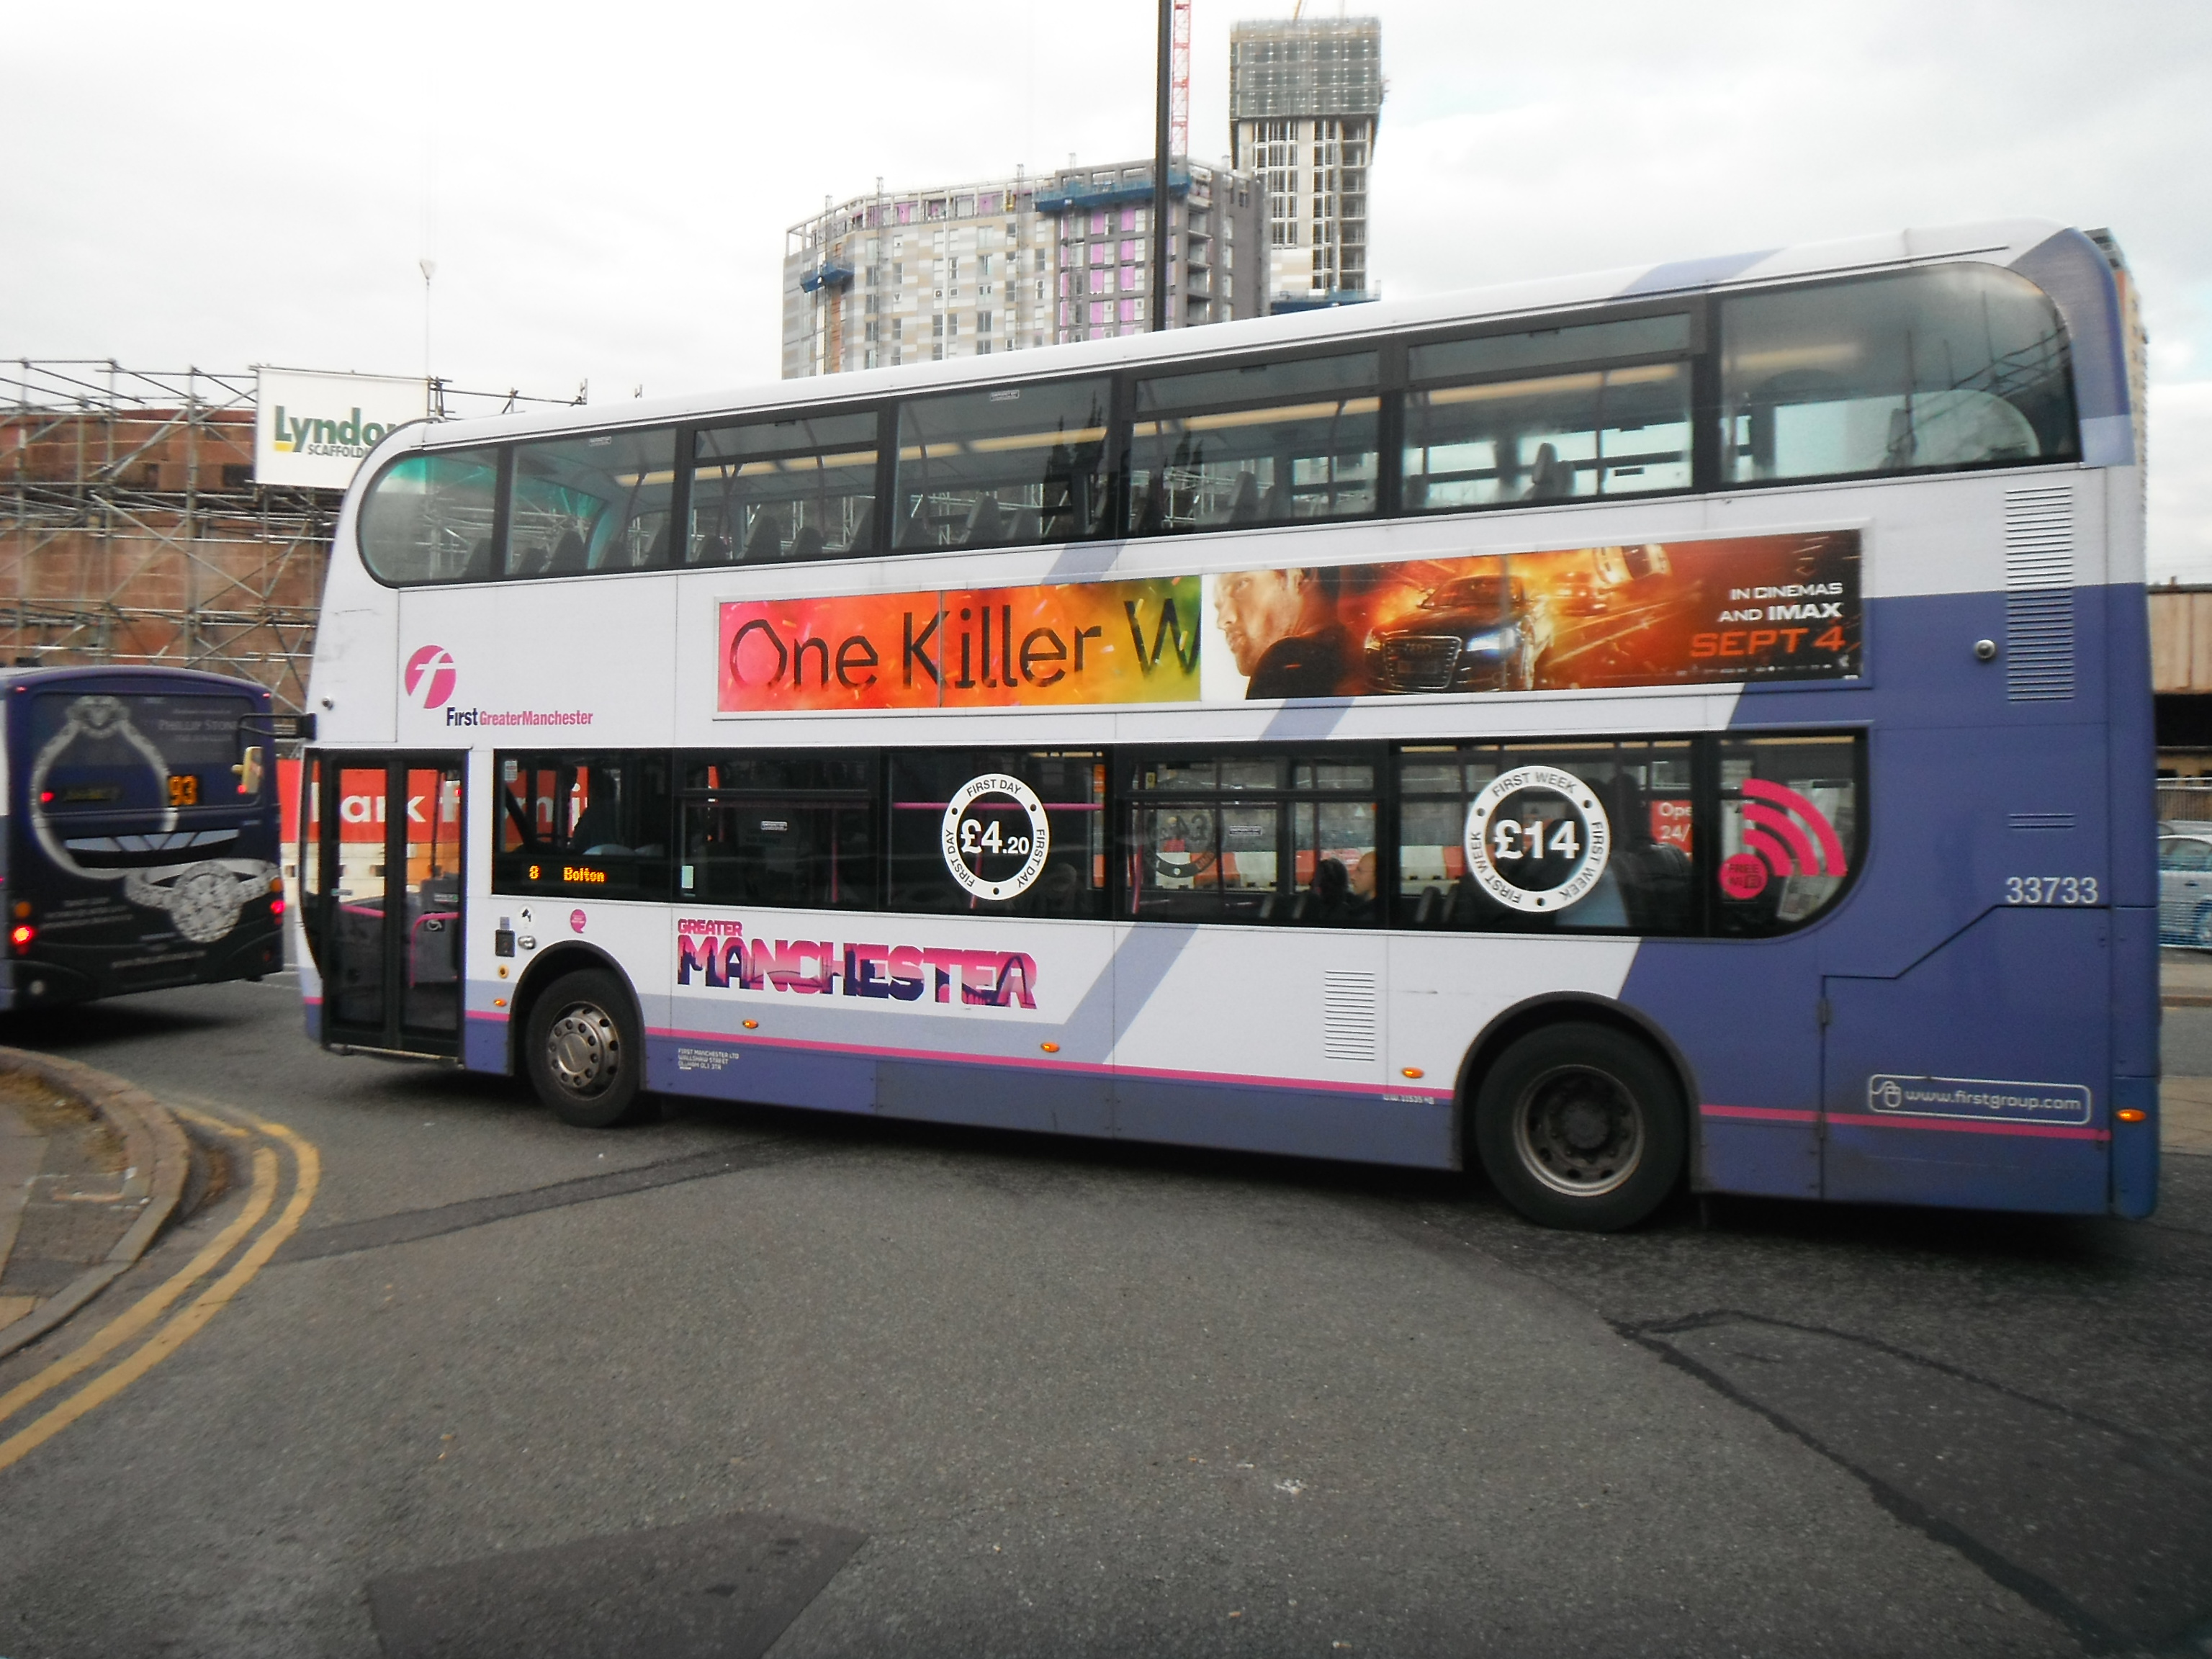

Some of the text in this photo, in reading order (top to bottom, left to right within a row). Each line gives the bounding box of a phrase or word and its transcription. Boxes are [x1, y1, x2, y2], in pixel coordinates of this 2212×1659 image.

[275, 405, 397, 453] Lyndo
[308, 443, 369, 459] SCAFFOLD
[1731, 582, 1843, 601] IN CINEMAS
[1717, 602, 1843, 623] AND IMAX
[729, 619, 878, 693] One
[902, 604, 1102, 690] Killer
[1691, 625, 1846, 657] SEPT 4
[446, 707, 594, 727] First GreaterManchester
[168, 775, 197, 806] 93
[966, 778, 1022, 797] FIRST DAY
[1491, 771, 1578, 797] FIRST WEEK
[961, 818, 1030, 855] £4.20
[1494, 819, 1580, 860] £14
[529, 865, 605, 883] 8 Bolton
[945, 829, 976, 888] FIRST DAY
[1017, 829, 1045, 889] FIRST DAY
[1470, 831, 1524, 904] FIRST WEEK
[1558, 821, 1605, 901] FIRST WEEK
[2005, 876, 2098, 904] 33733
[678, 919, 742, 936] GREATER
[678, 935, 1037, 1010] MANCHESTER
[1905, 1089, 2082, 1110] www.firstgroup.com
